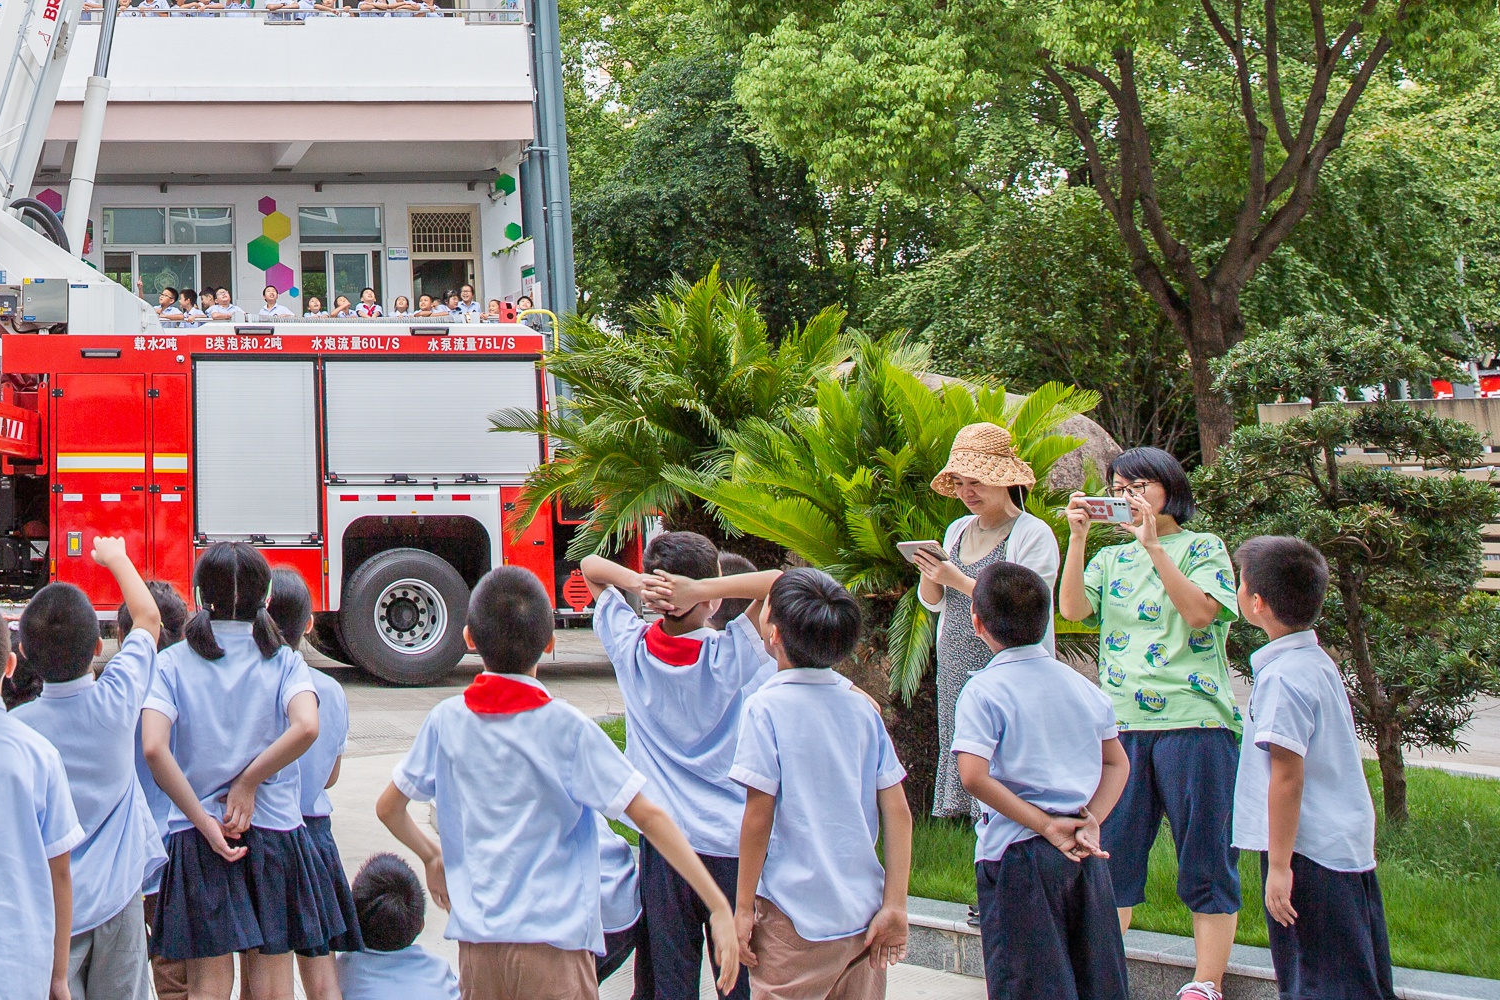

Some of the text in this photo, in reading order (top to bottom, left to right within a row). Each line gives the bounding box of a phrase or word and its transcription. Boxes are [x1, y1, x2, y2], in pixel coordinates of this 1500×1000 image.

[134, 336, 177, 351] 载水2吨
[205, 336, 283, 351] B类泡沫0.2吨
[311, 336, 400, 351] 水炮流量60L/S
[427, 336, 516, 352] 水泵流量75L/S
[1138, 603, 1162, 613] Mterial
[1105, 634, 1131, 645] Material
[1134, 691, 1167, 704] Material
